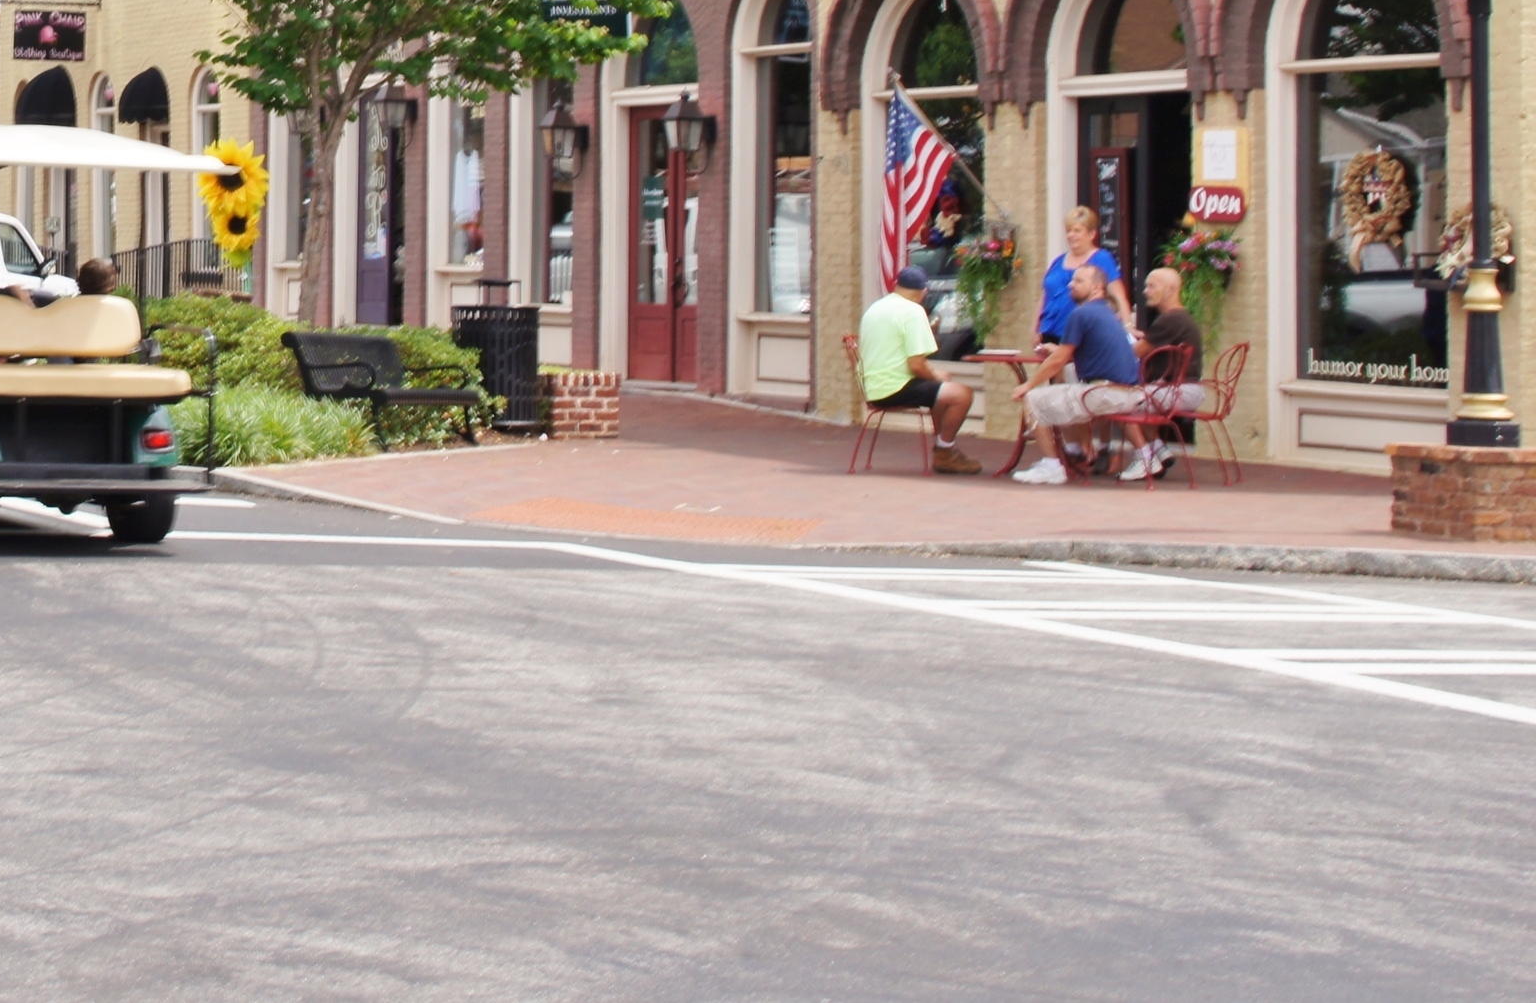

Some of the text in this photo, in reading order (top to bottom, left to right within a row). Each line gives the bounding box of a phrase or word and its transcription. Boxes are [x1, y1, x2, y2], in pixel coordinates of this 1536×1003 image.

[15, 11, 43, 27] PINK
[14, 47, 47, 60] Clothing
[1189, 186, 1241, 220] Open
[1307, 347, 1363, 377] humor
[1366, 362, 1408, 384] your
